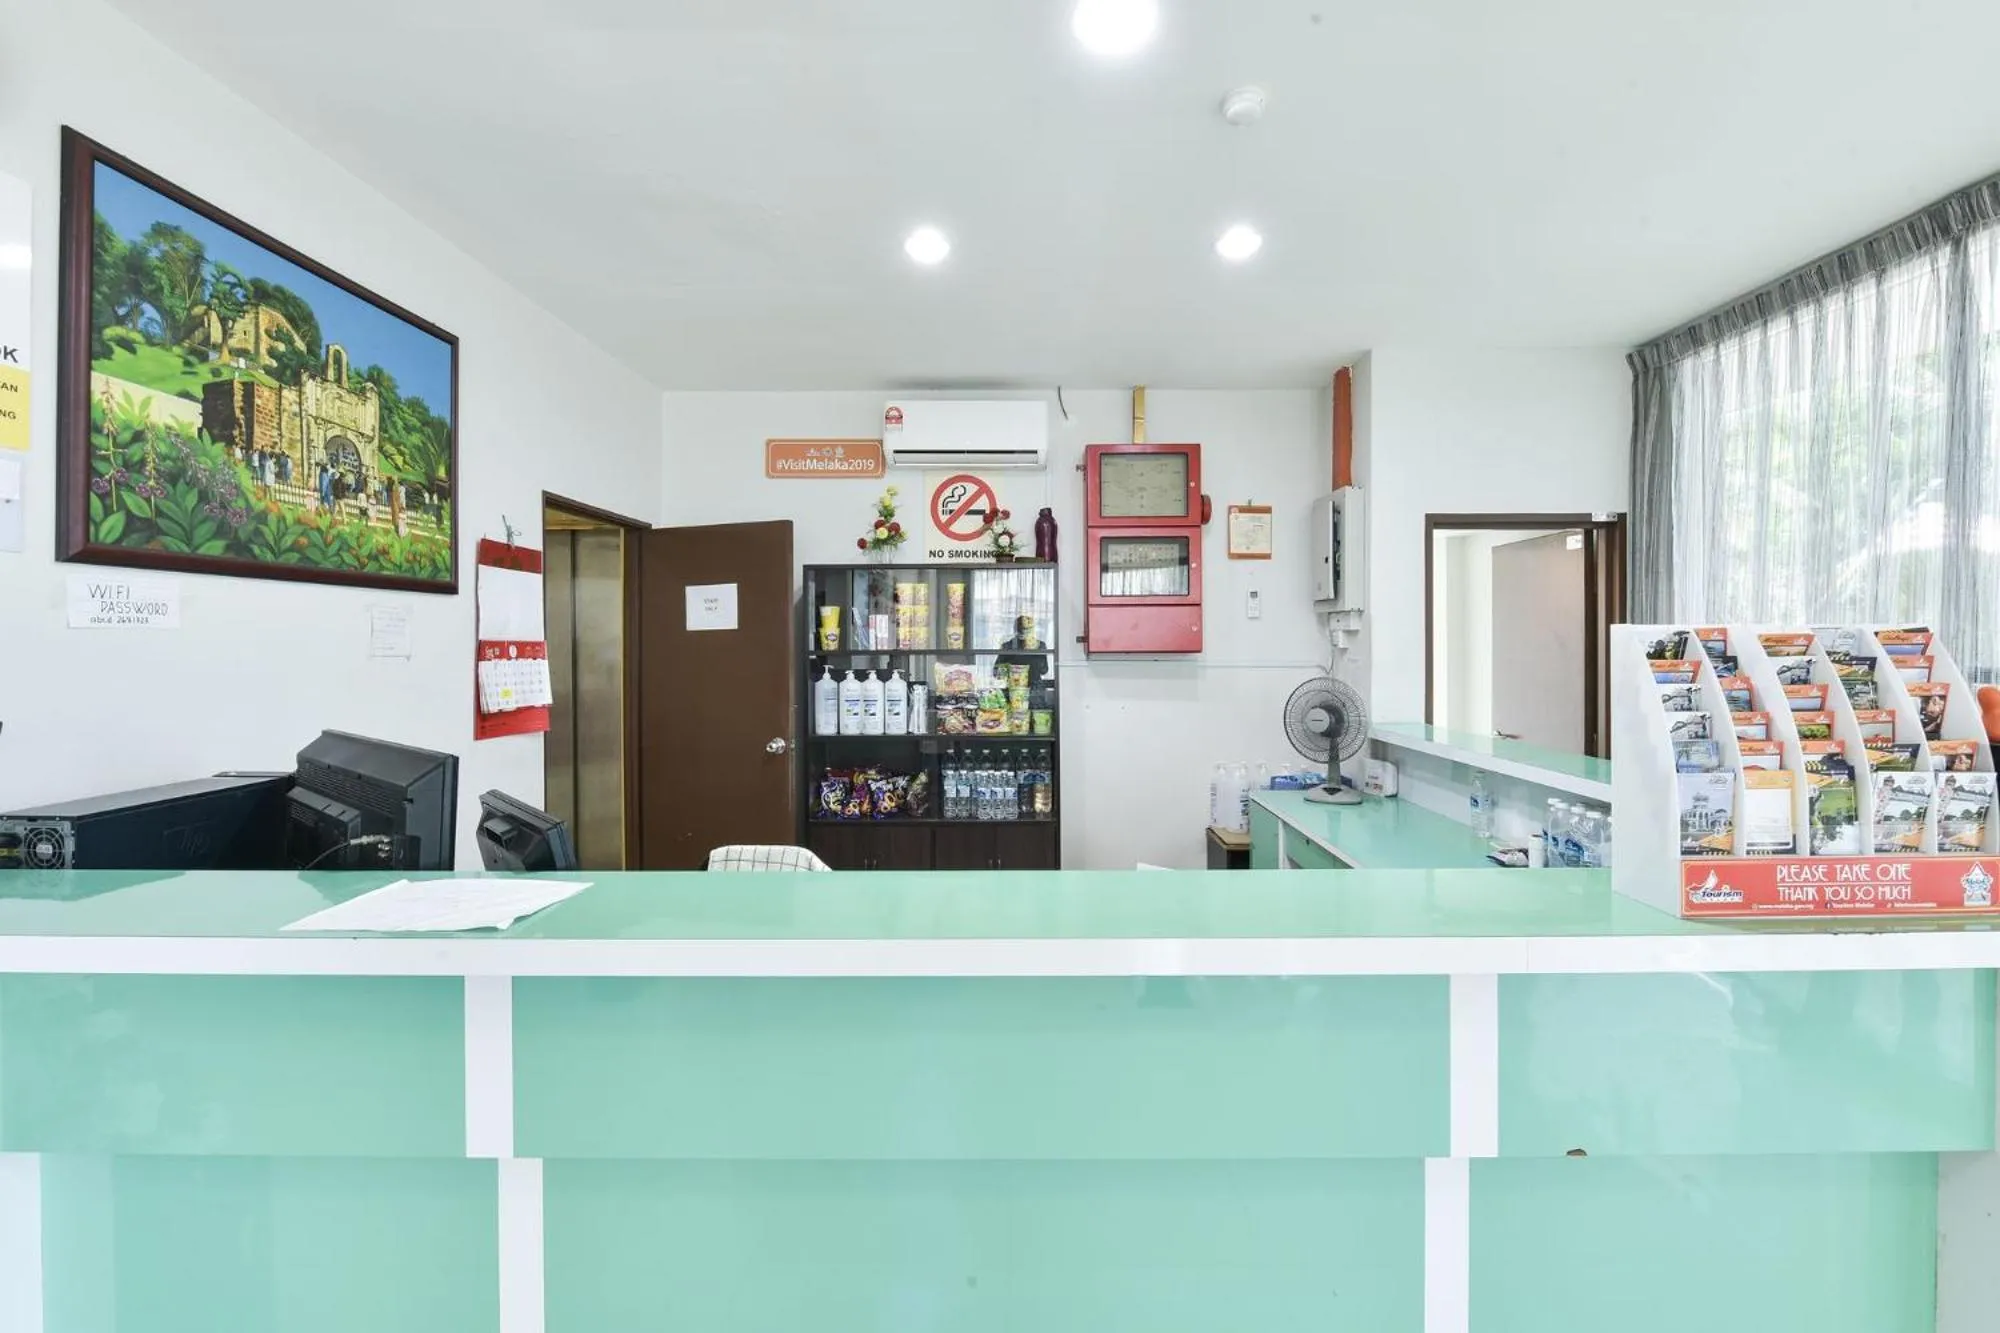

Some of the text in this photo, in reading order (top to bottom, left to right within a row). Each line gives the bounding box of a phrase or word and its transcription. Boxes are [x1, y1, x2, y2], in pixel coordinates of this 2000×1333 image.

[0, 345, 18, 363] K
[0, 381, 19, 393] AN
[776, 458, 875, 471] #VisitMelaka2019
[929, 549, 945, 558] NO
[87, 584, 130, 600] WIFI
[100, 600, 169, 616] PASSWORD
[1776, 863, 1912, 882] PLEASE TAKE ONE
[1776, 885, 1911, 901] THANK YOU SO MUCH
